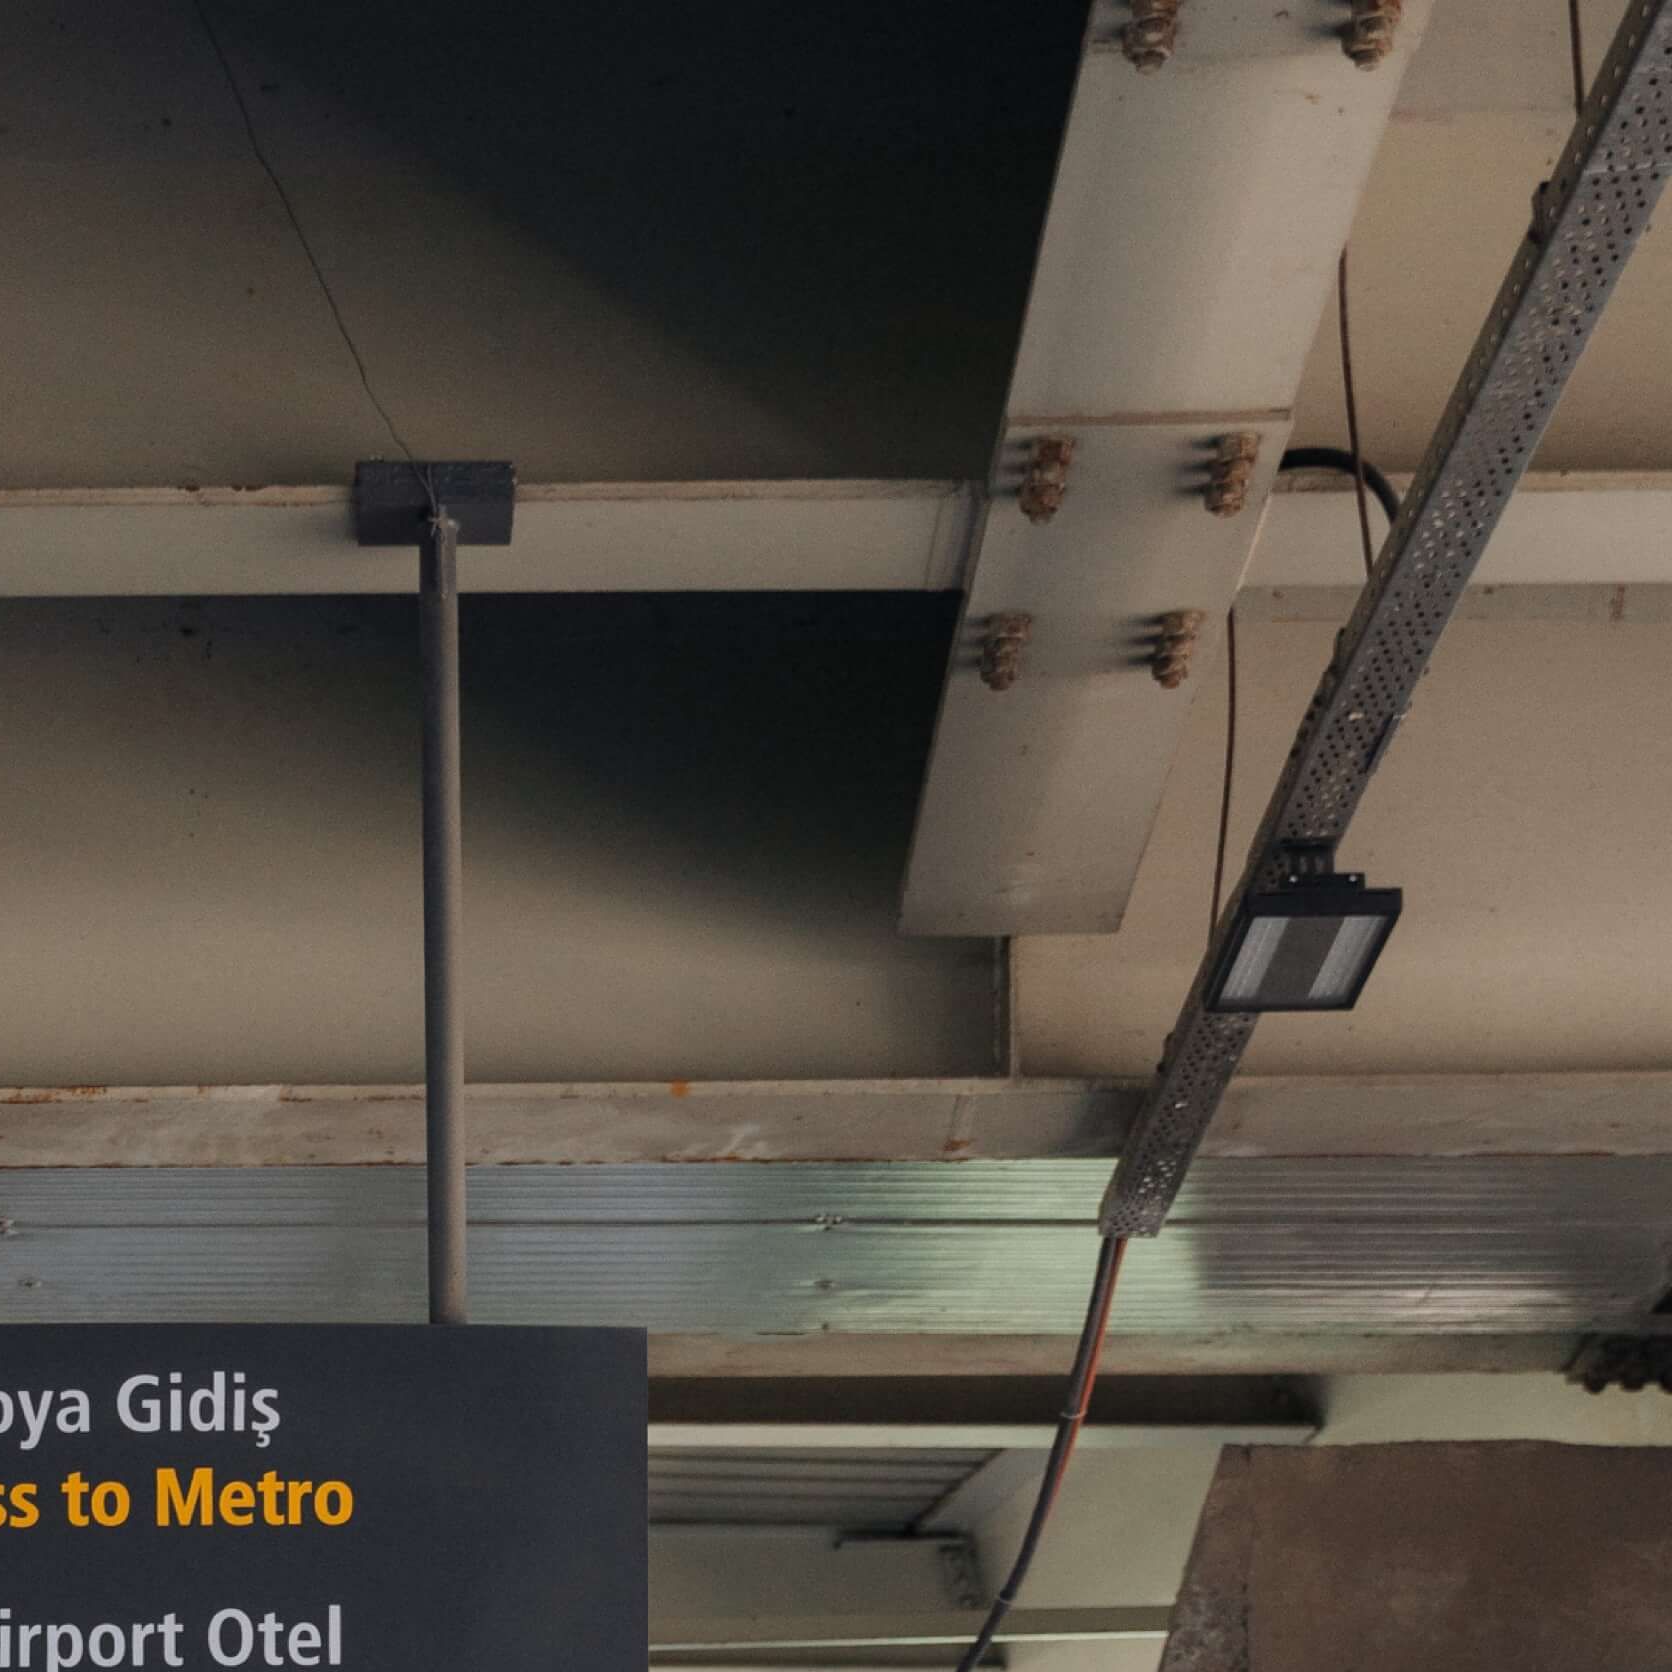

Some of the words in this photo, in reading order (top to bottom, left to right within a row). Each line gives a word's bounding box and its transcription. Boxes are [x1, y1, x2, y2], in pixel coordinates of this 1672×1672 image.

[116, 1370, 281, 1448] Gidiş
[61, 1471, 130, 1527] to
[156, 1467, 353, 1527] Metro
[207, 1604, 341, 1667] Otel
